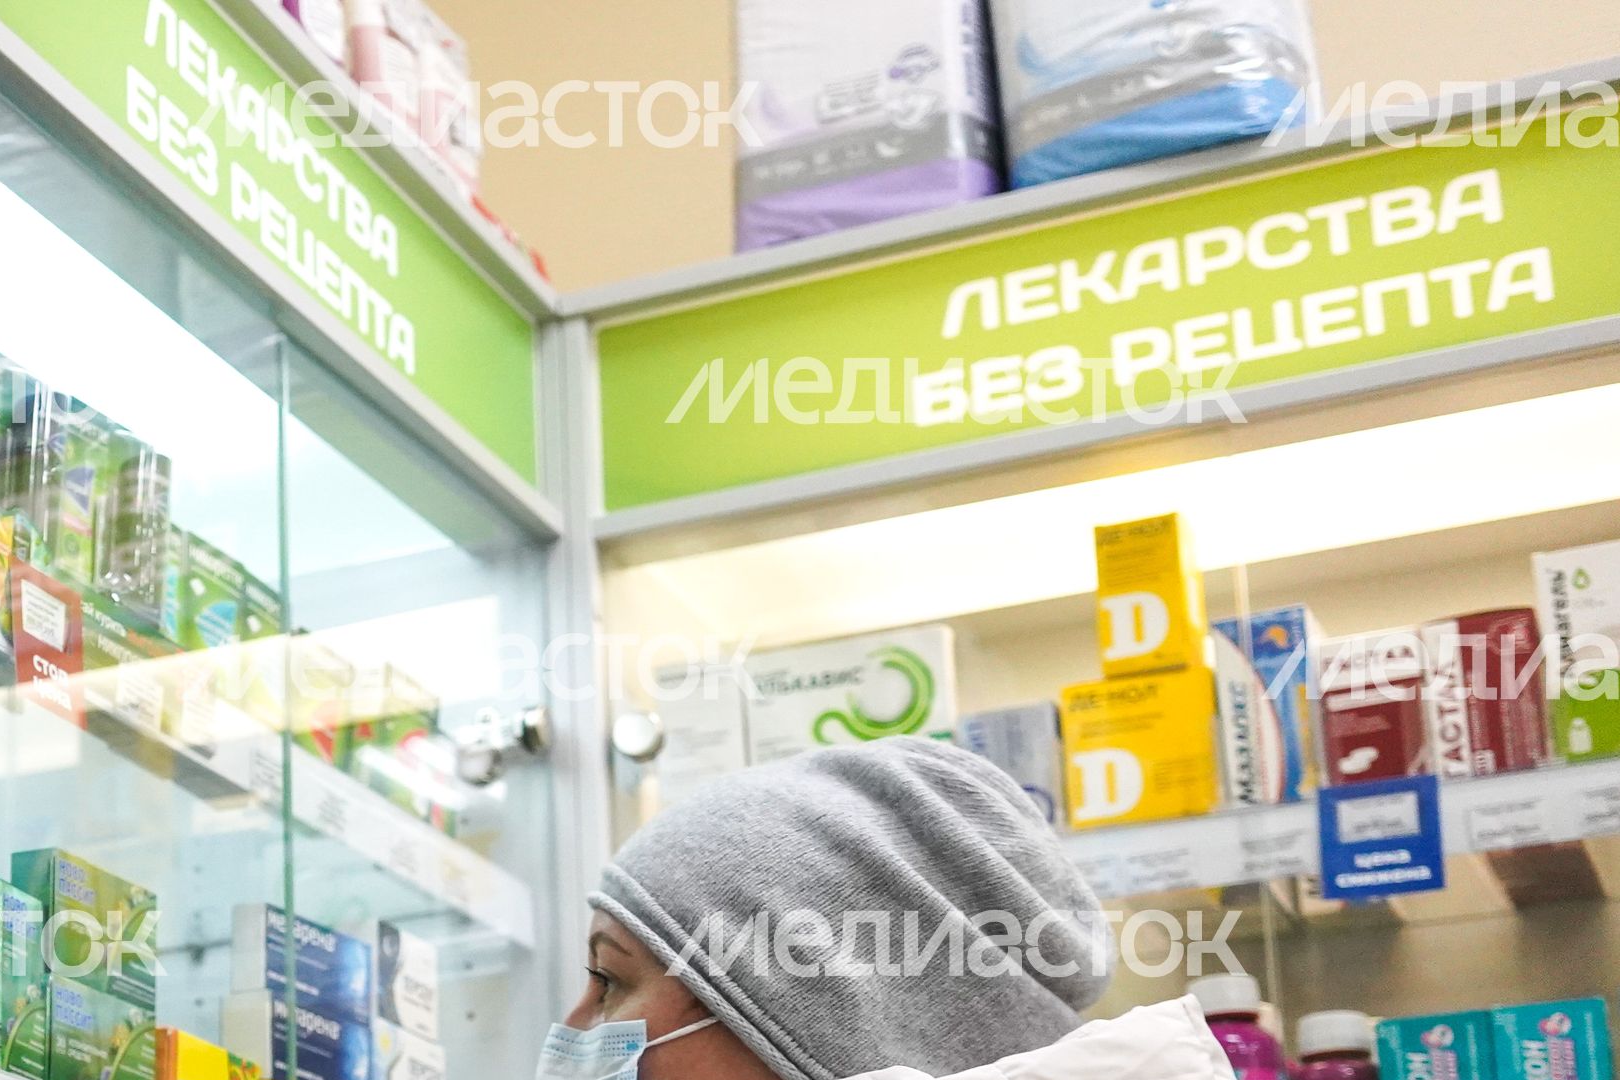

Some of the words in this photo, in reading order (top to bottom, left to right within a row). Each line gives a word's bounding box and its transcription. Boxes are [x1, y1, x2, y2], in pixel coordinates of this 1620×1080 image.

[126, 65, 218, 197] БЕЗ
[230, 161, 416, 375] РЕЦЕПТА
[145, 0, 398, 277] ЛЕКАРСТВА
[911, 343, 1082, 428] БЕЗ
[1113, 248, 1554, 386] РЕЦЕПТА
[940, 168, 1505, 340] ЛЕКАРСТВА
[1100, 592, 1169, 662] D
[1073, 747, 1144, 820] D
